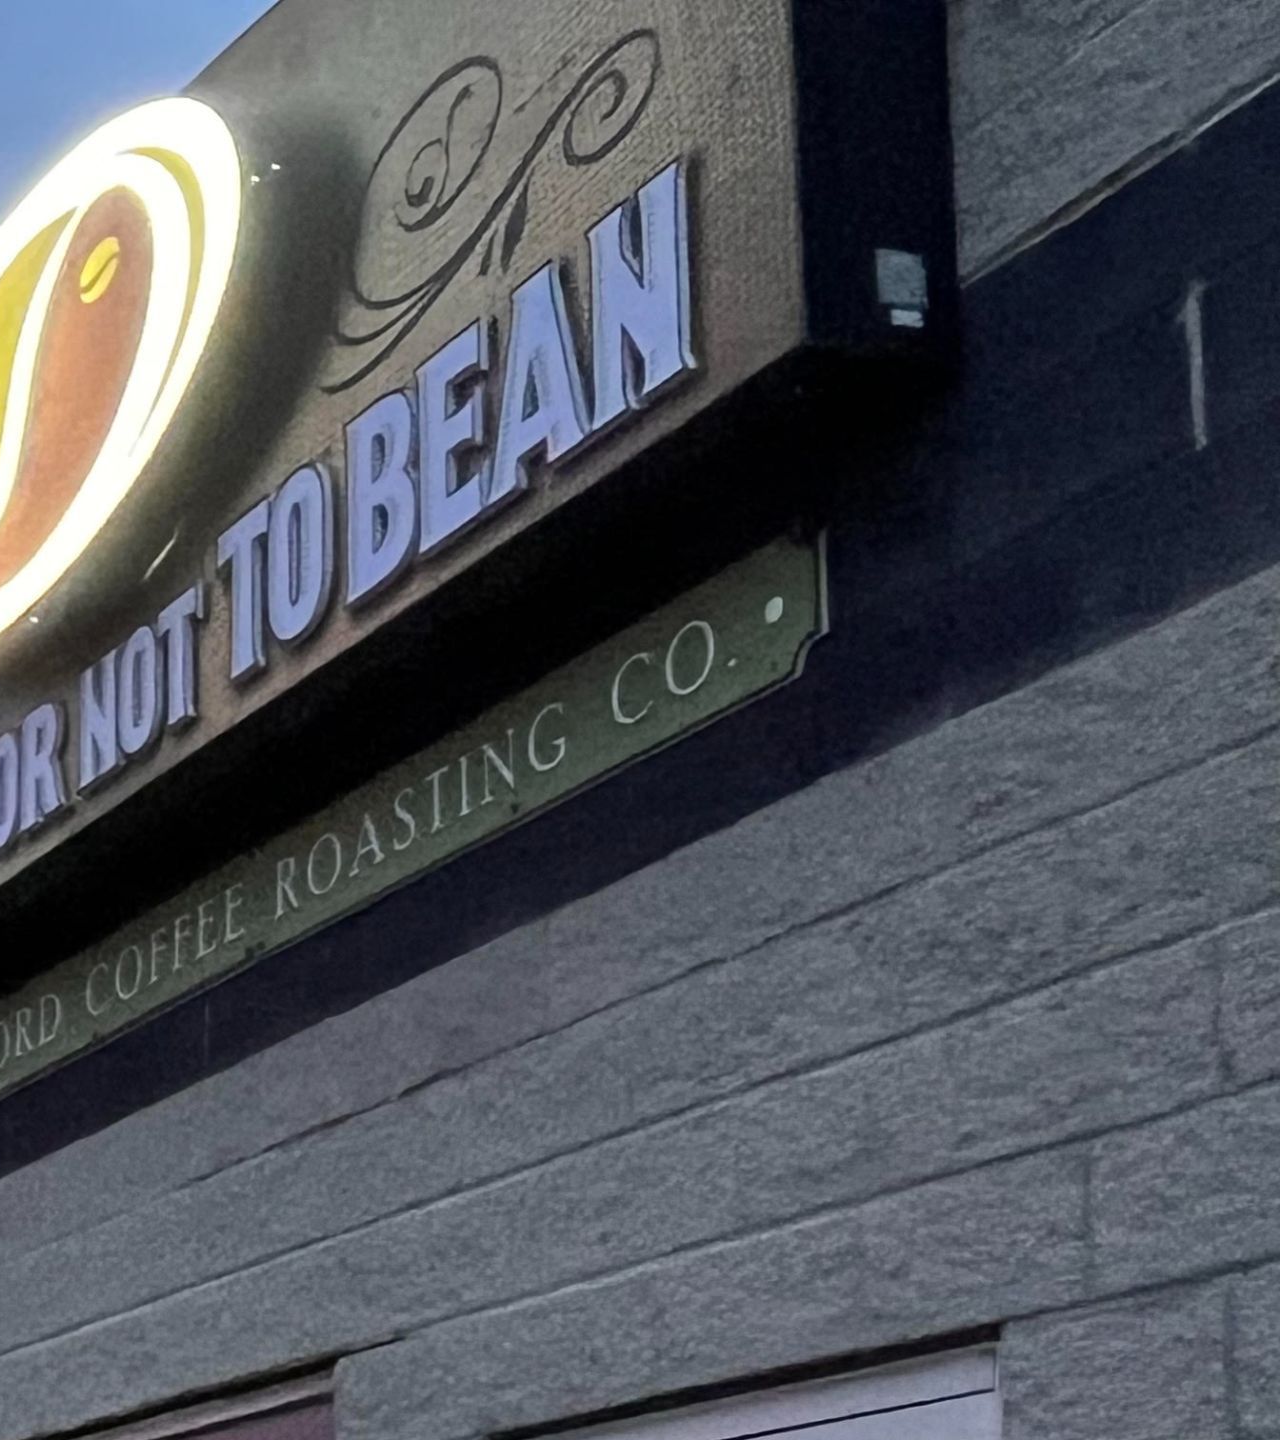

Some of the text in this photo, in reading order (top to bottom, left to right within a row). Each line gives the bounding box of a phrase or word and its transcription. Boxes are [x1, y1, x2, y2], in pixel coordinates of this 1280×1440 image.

[79, 580, 204, 795] NOT
[217, 463, 331, 679] TO
[344, 161, 697, 604] BEAN
[85, 883, 245, 1016] COFFEE
[275, 703, 566, 920] ROASTING
[611, 620, 737, 723] CO.
